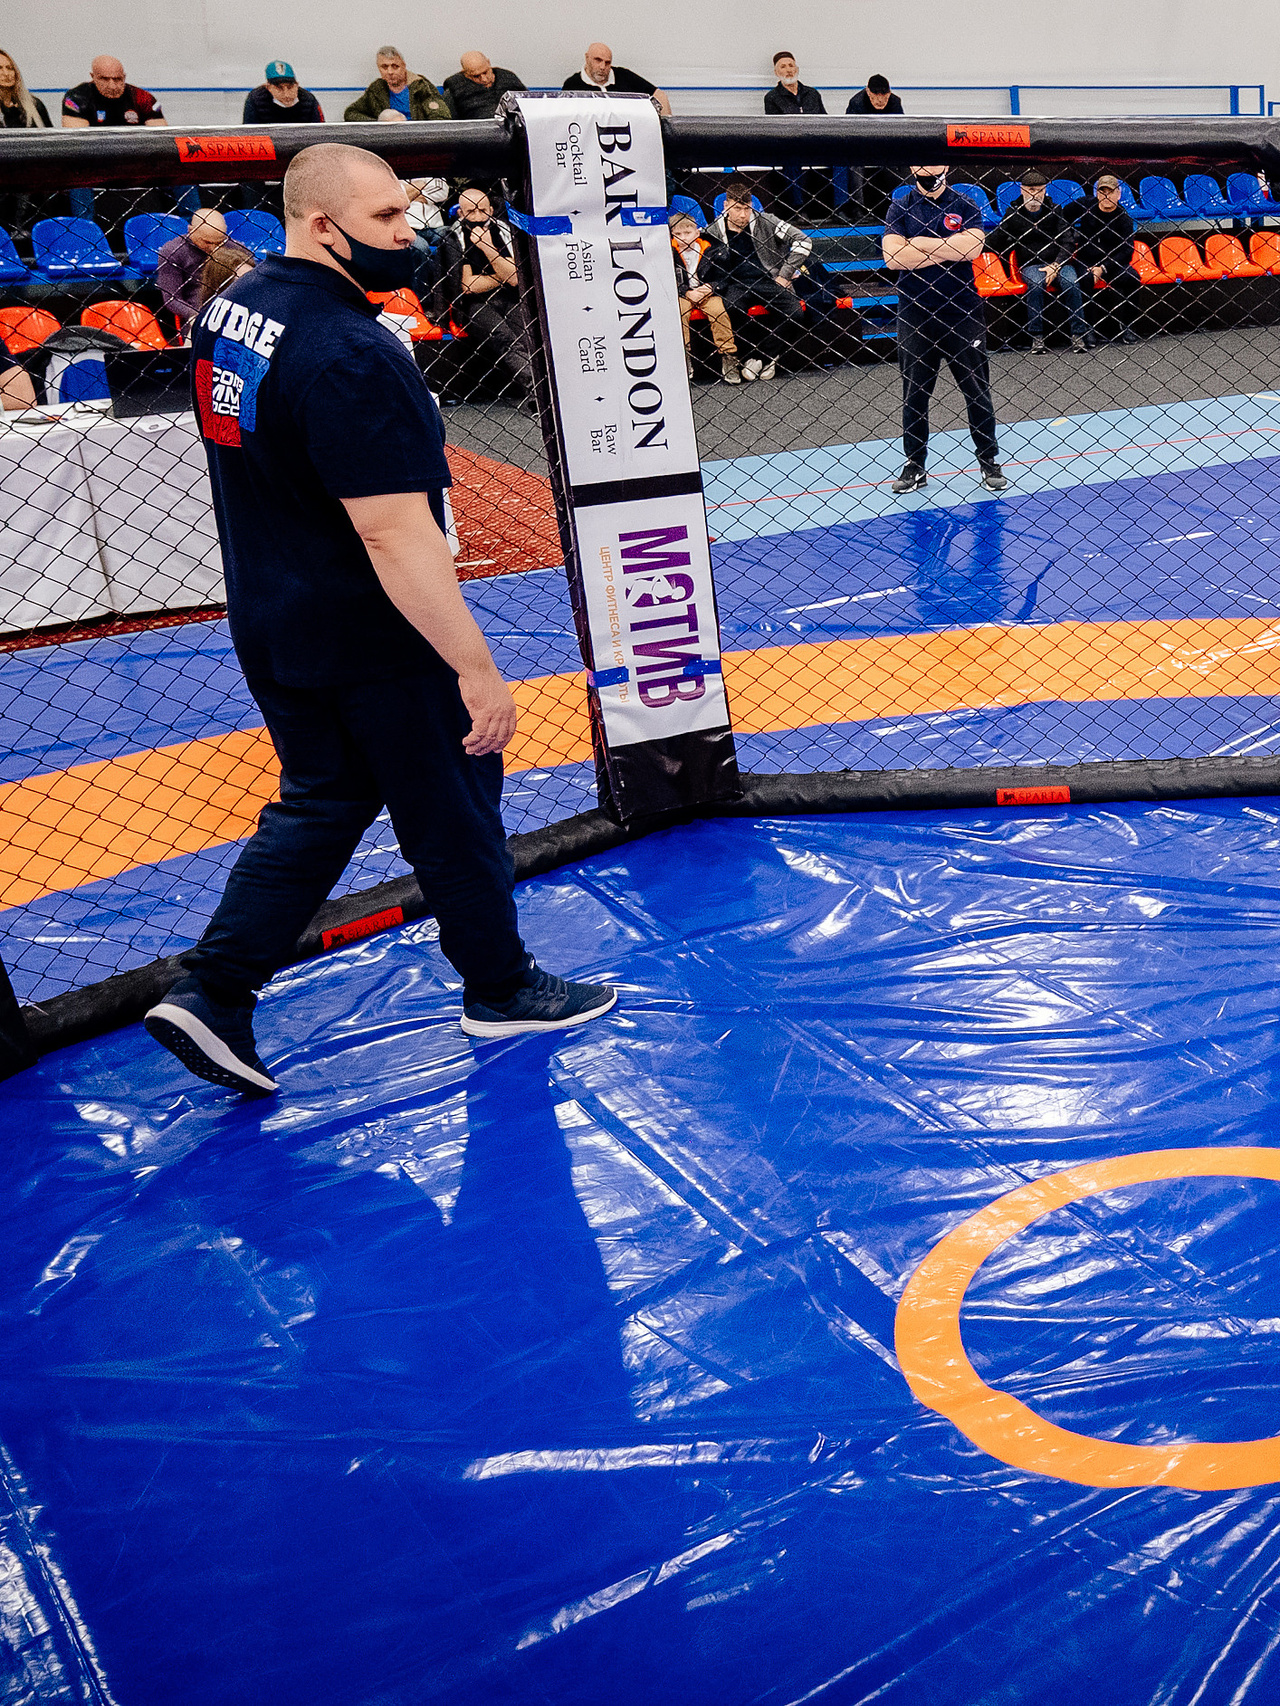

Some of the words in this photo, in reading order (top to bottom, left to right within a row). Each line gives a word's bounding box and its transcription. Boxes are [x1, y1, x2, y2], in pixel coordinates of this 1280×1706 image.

[206, 142, 269, 157] SPARTA
[555, 141, 568, 168] Bar
[568, 122, 588, 186] Cocktail
[971, 131, 1025, 143] SPARTA
[595, 122, 639, 226] BAR
[565, 242, 583, 280] Food
[580, 239, 596, 282] Asian
[200, 297, 286, 359] JUDGE
[608, 237, 669, 450] LONDON
[577, 337, 595, 374] Card
[592, 335, 608, 373] Meat
[590, 428, 604, 453] Bar
[604, 423, 618, 455] Raw
[599, 546, 614, 582] ЦЕНТР
[605, 584, 621, 638] ФИТНЕСА
[612, 640, 622, 648] И
[615, 651, 631, 704] КРОТЫ
[1018, 791, 1066, 802] SPARTA
[349, 914, 401, 939] SPARTA
